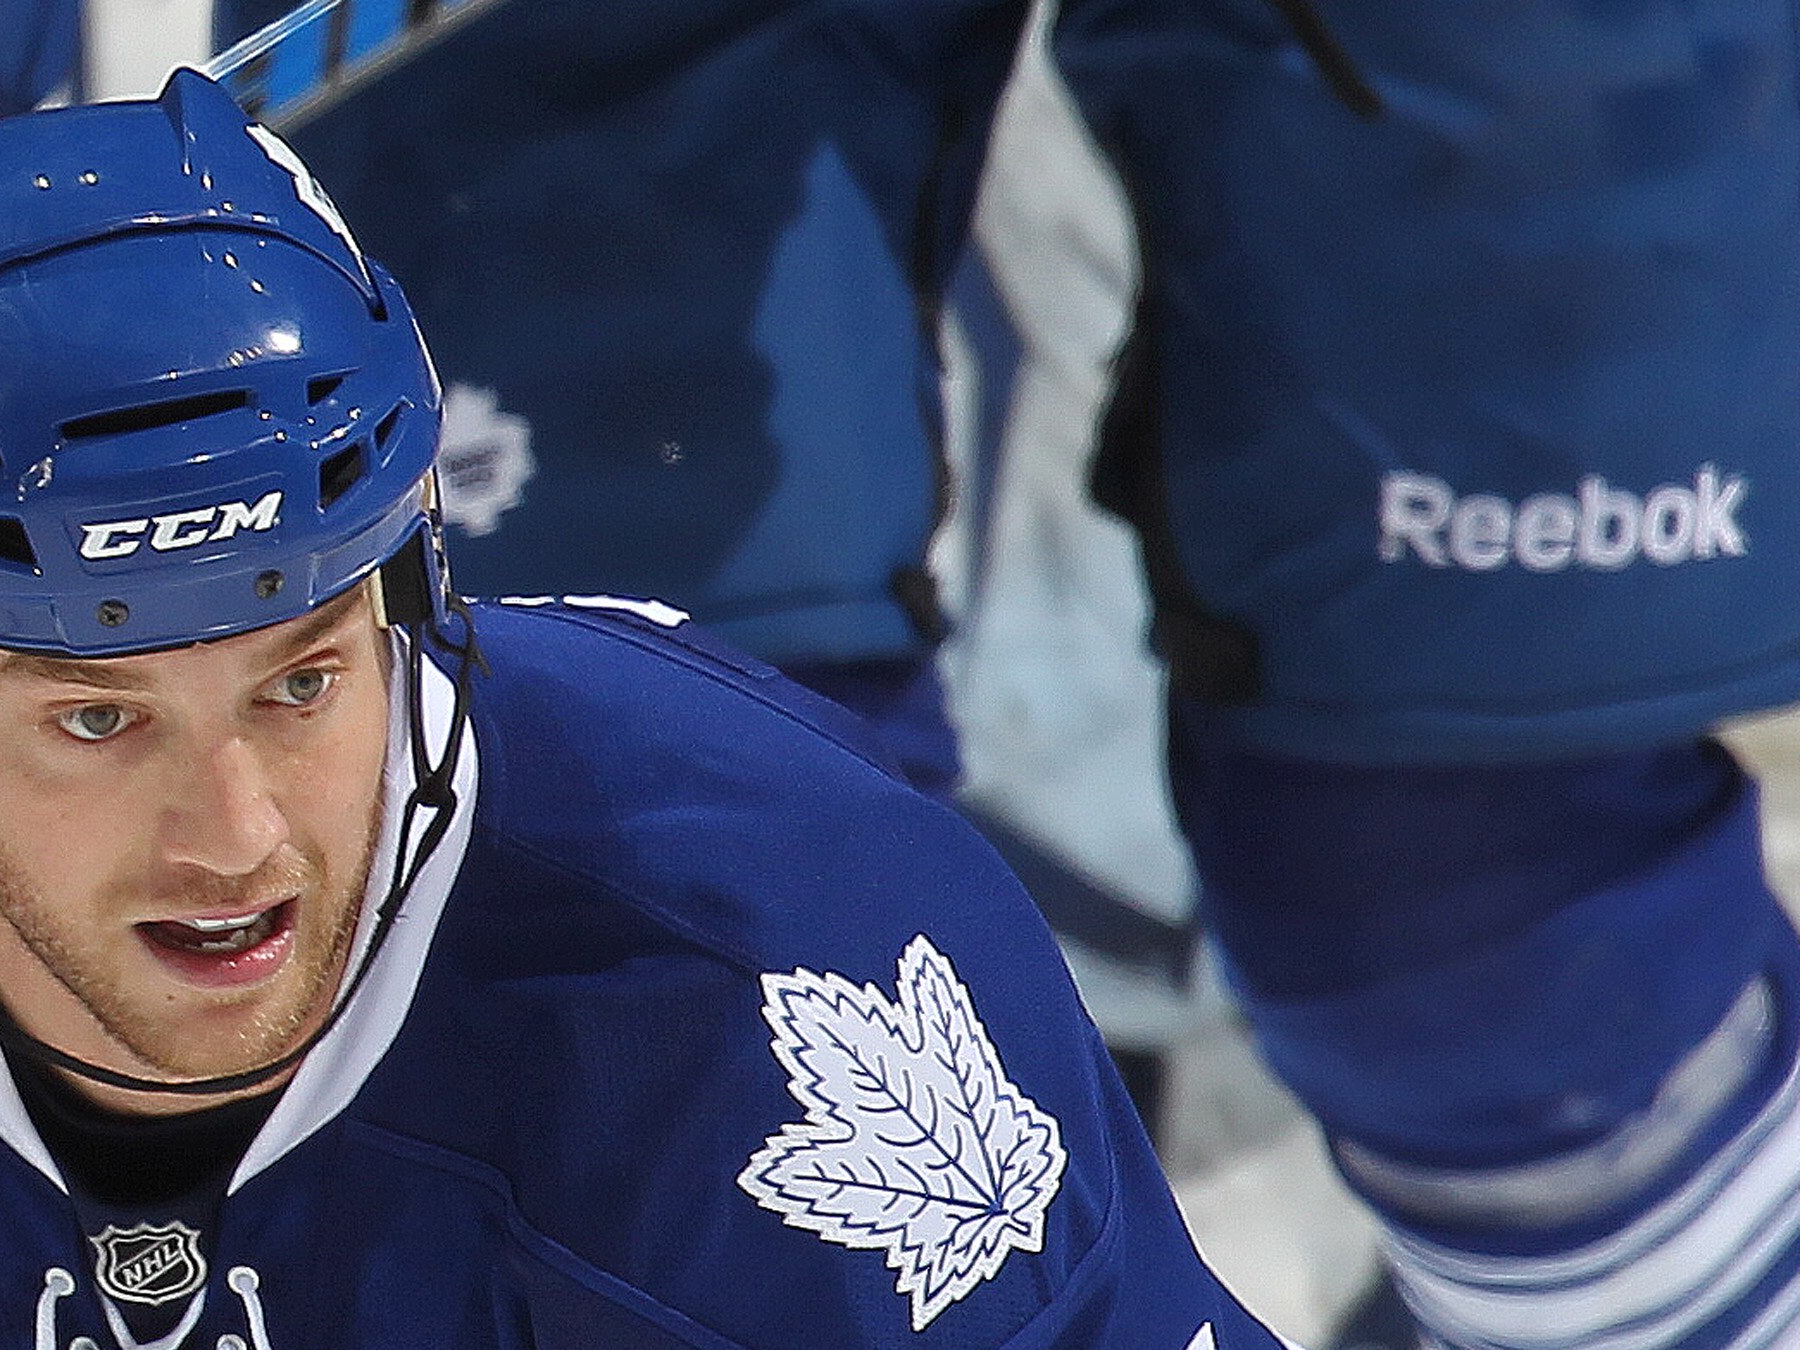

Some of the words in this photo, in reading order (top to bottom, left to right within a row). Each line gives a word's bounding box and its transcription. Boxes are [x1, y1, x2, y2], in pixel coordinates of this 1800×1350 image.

[80, 491, 283, 559] CCM
[1375, 462, 1752, 573] Reebok
[120, 1241, 180, 1288] NHL
